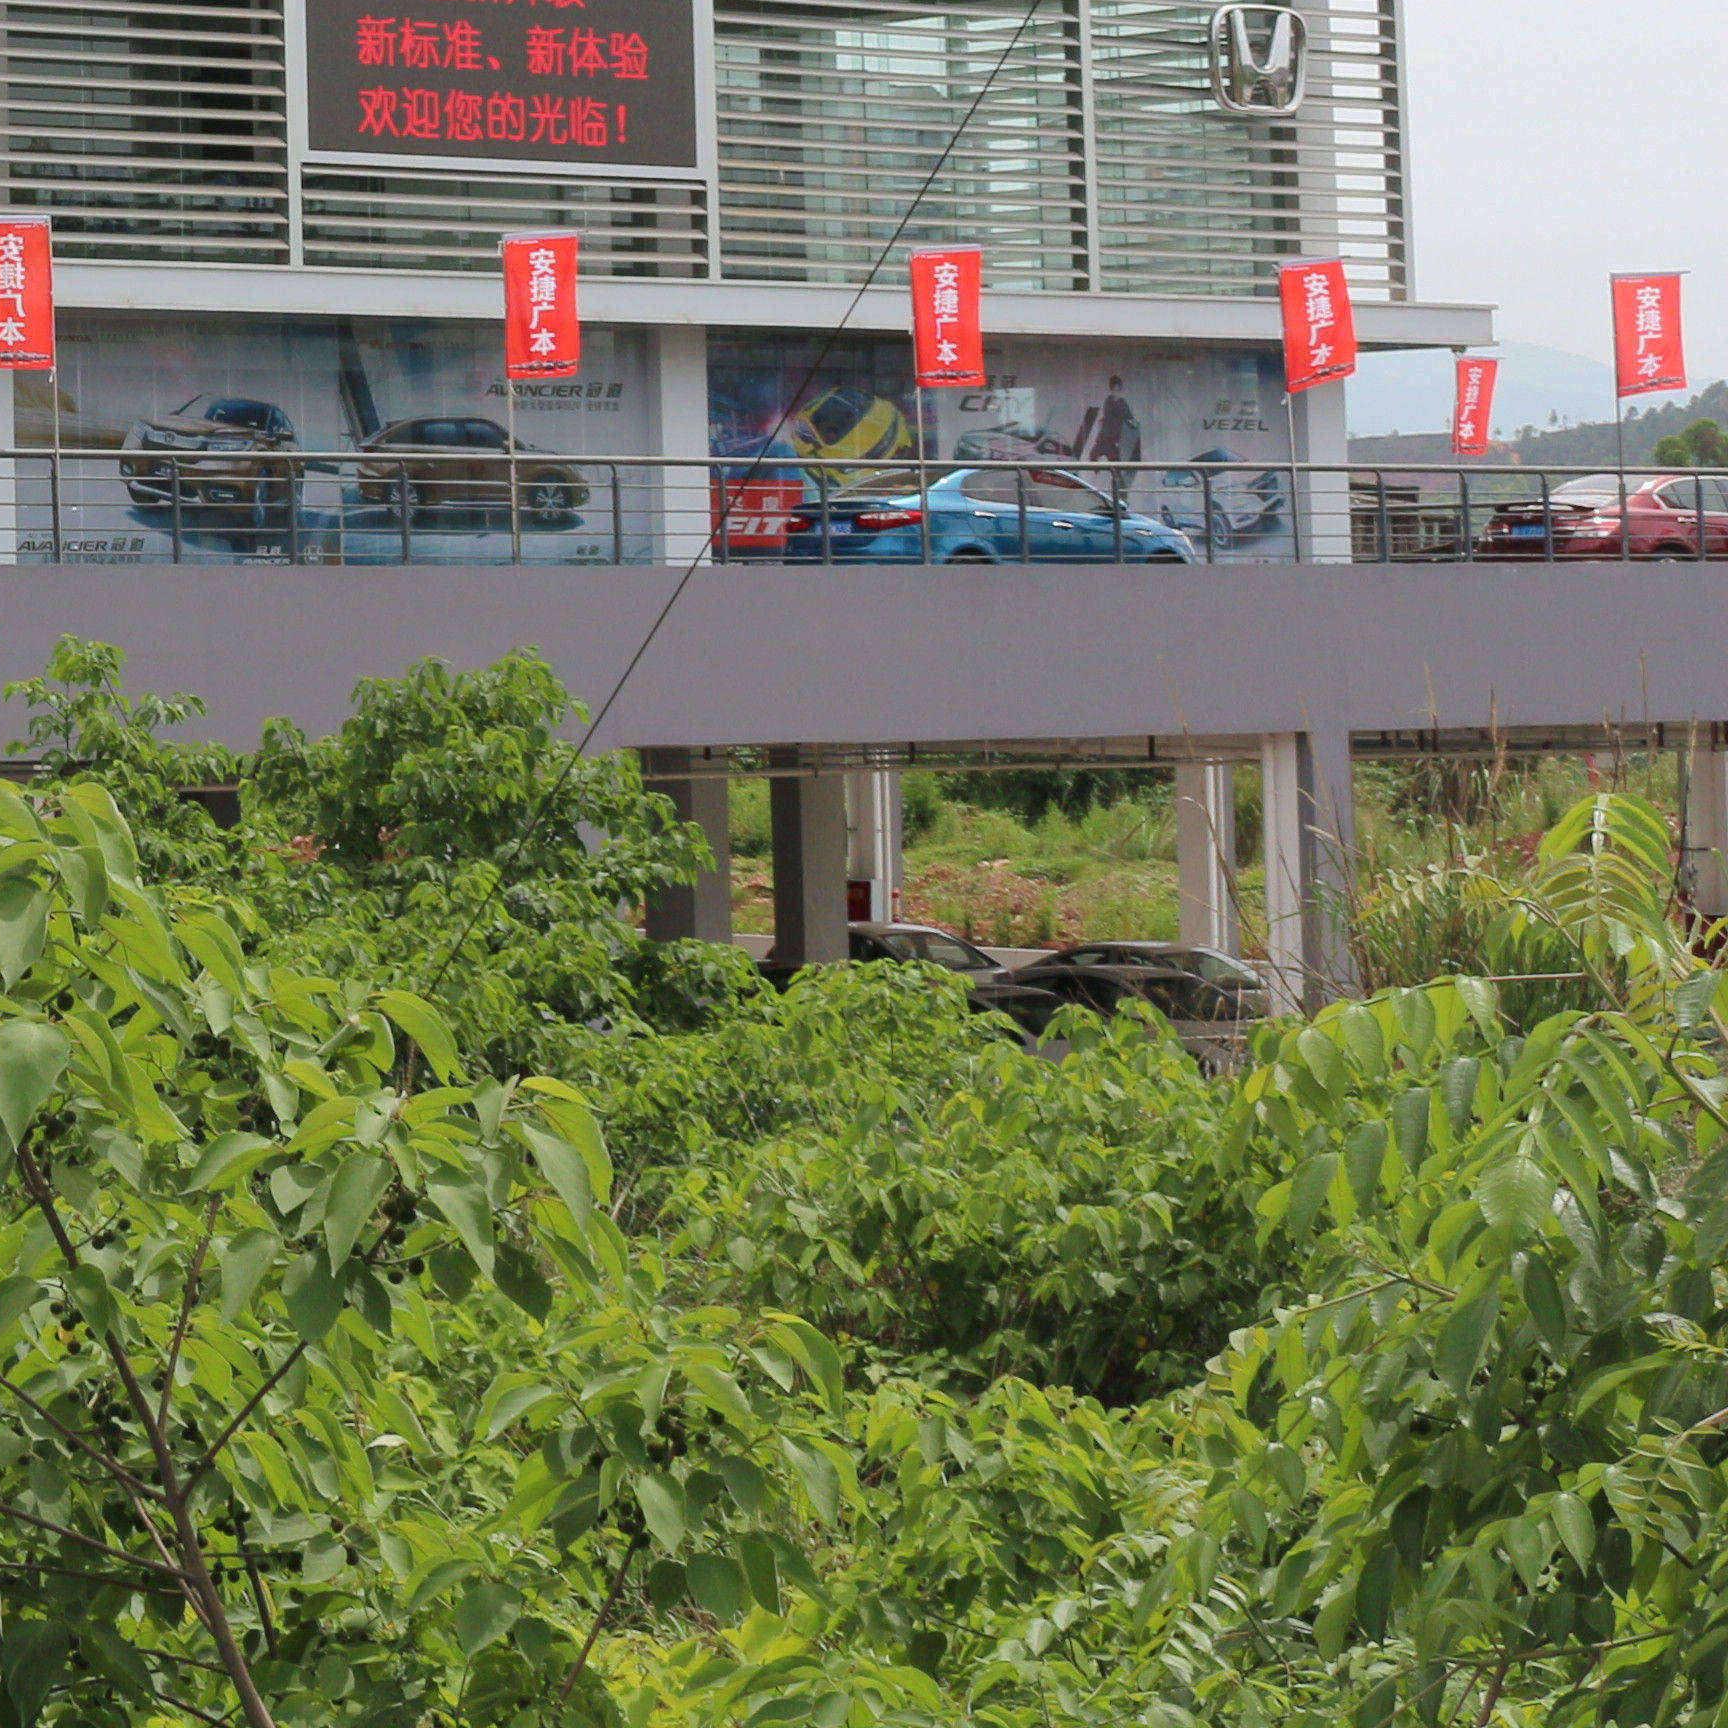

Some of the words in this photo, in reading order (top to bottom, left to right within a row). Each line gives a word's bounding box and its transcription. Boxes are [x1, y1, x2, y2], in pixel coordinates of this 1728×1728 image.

[355, 15, 649, 80] 新标准、新体验
[358, 86, 628, 147] 欢迎您的光临！
[529, 248, 556, 356] 安捷广本
[933, 262, 959, 365] 安捷广本
[1635, 286, 1663, 377] 安捷广本
[1203, 418, 1271, 431] VEZEL
